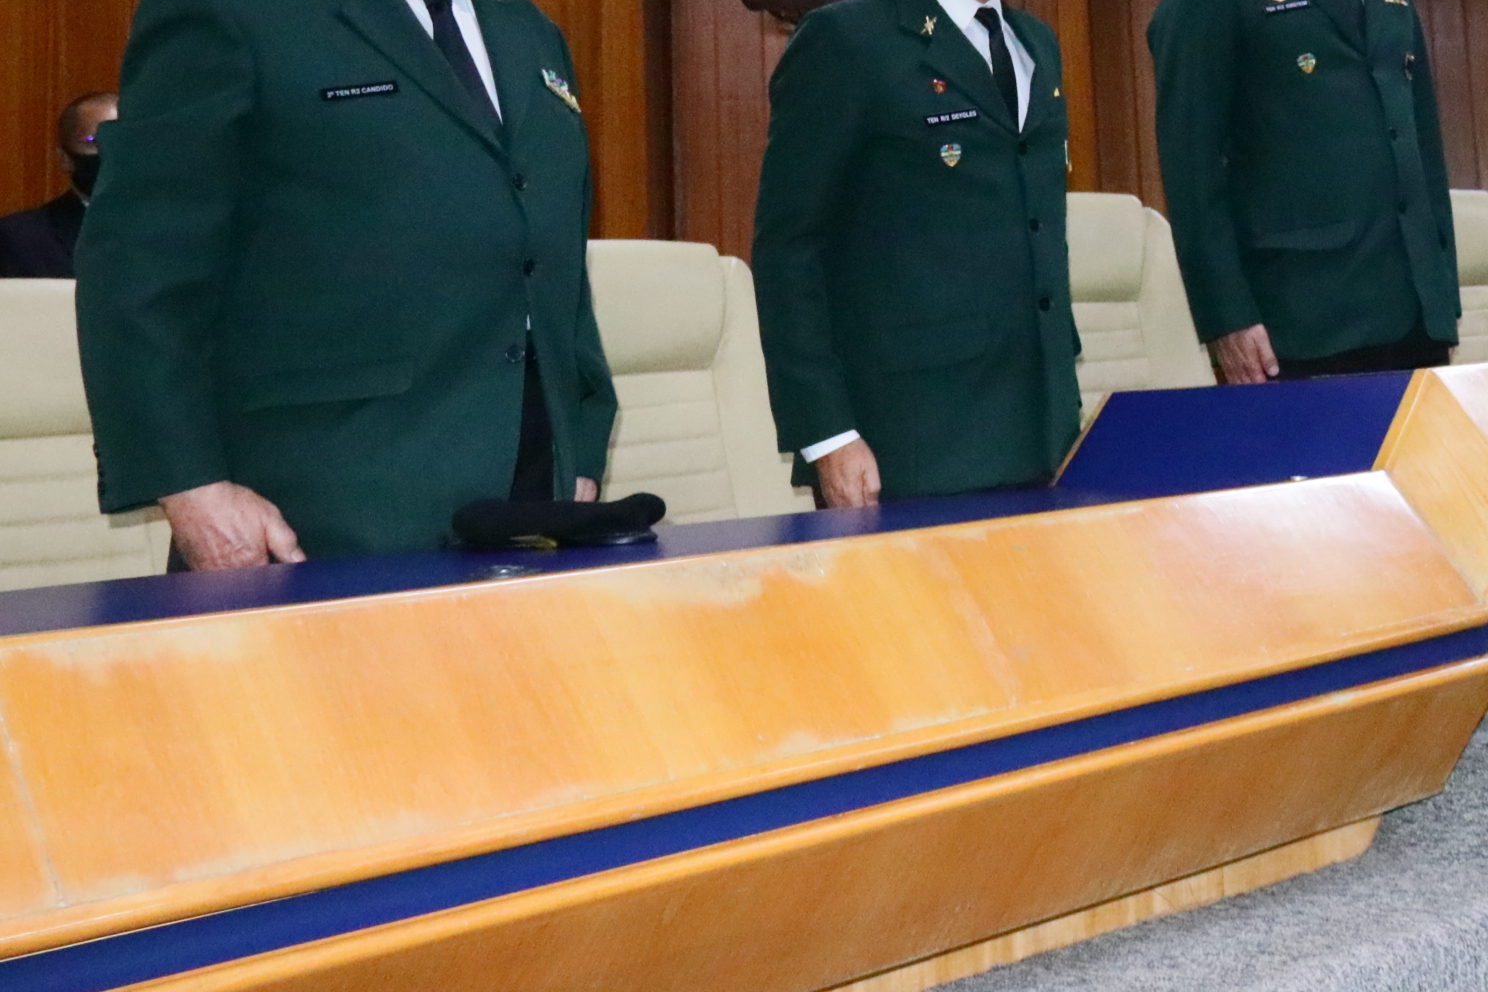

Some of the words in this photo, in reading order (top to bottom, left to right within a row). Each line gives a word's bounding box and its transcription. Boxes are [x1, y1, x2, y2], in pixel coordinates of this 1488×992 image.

[335, 89, 350, 97] TEN
[361, 84, 394, 94] CANDIDO
[926, 116, 939, 124] TEN
